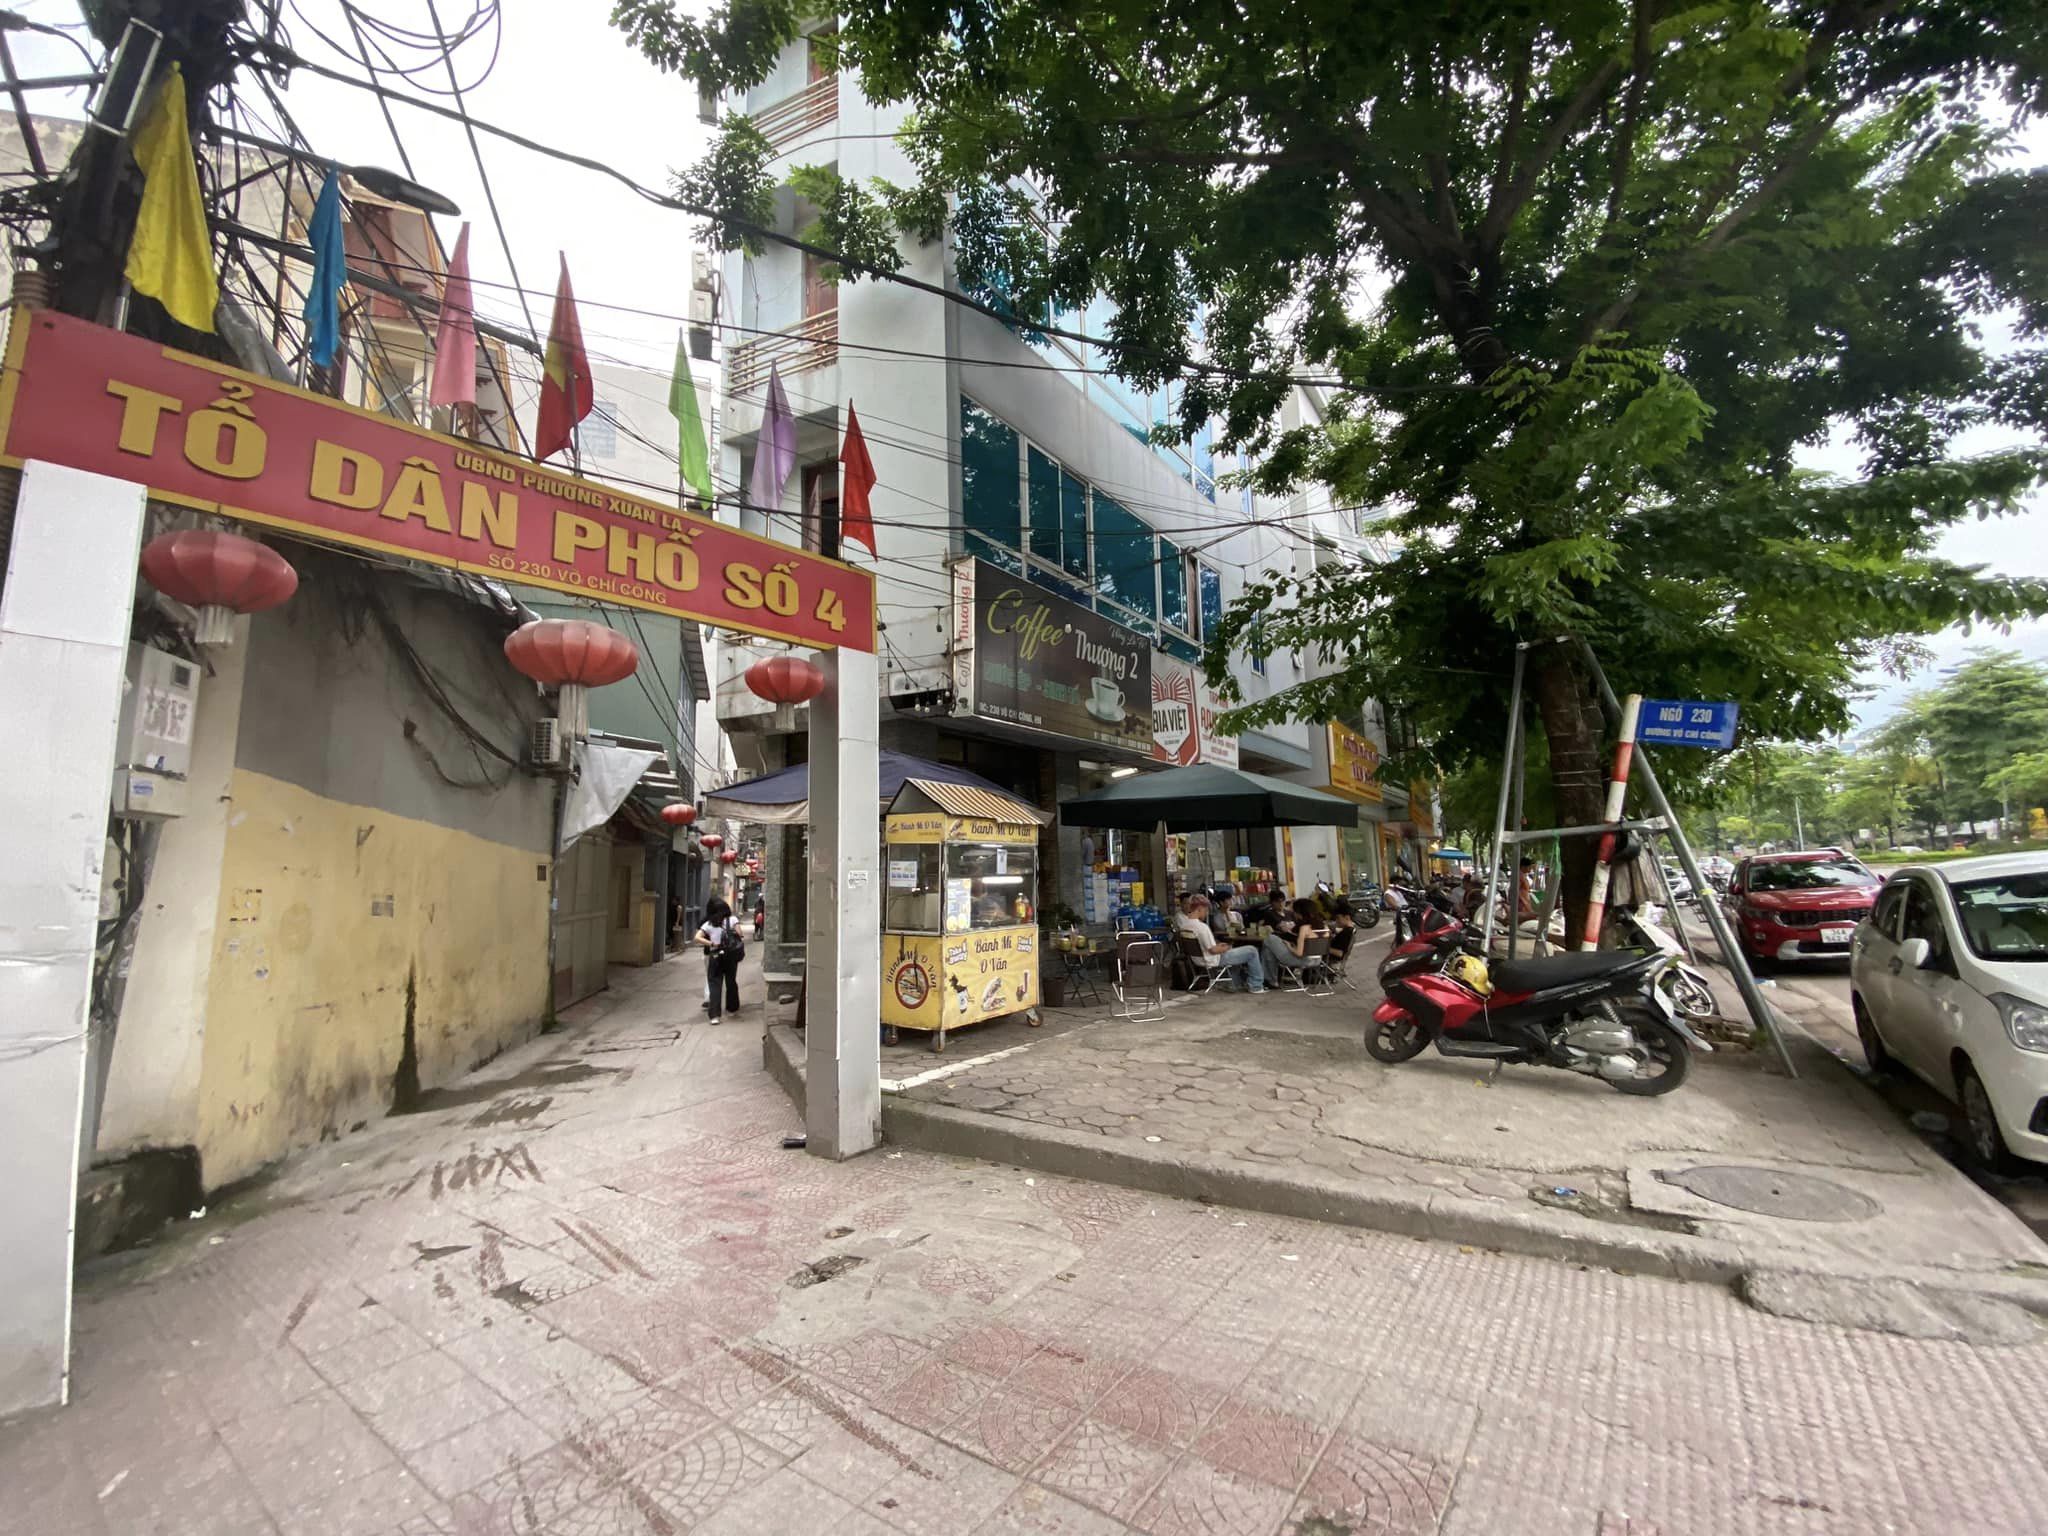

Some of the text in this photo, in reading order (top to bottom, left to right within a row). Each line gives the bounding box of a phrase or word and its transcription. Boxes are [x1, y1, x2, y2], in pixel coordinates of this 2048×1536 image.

[455, 451, 517, 483] UBND
[105, 379, 847, 632] TỔ DÂN PHỐ SỐ 4
[487, 551, 516, 571] SỐ
[519, 560, 551, 579] 230
[587, 574, 616, 594] CHÍ
[619, 582, 668, 605] CÔNG
[986, 588, 1065, 661] Coffee
[1129, 652, 1138, 679] 2
[1153, 708, 1168, 733] BIA
[1168, 706, 1188, 735] VIỆT
[1690, 708, 1713, 724] 230
[975, 937, 999, 954] Bánh
